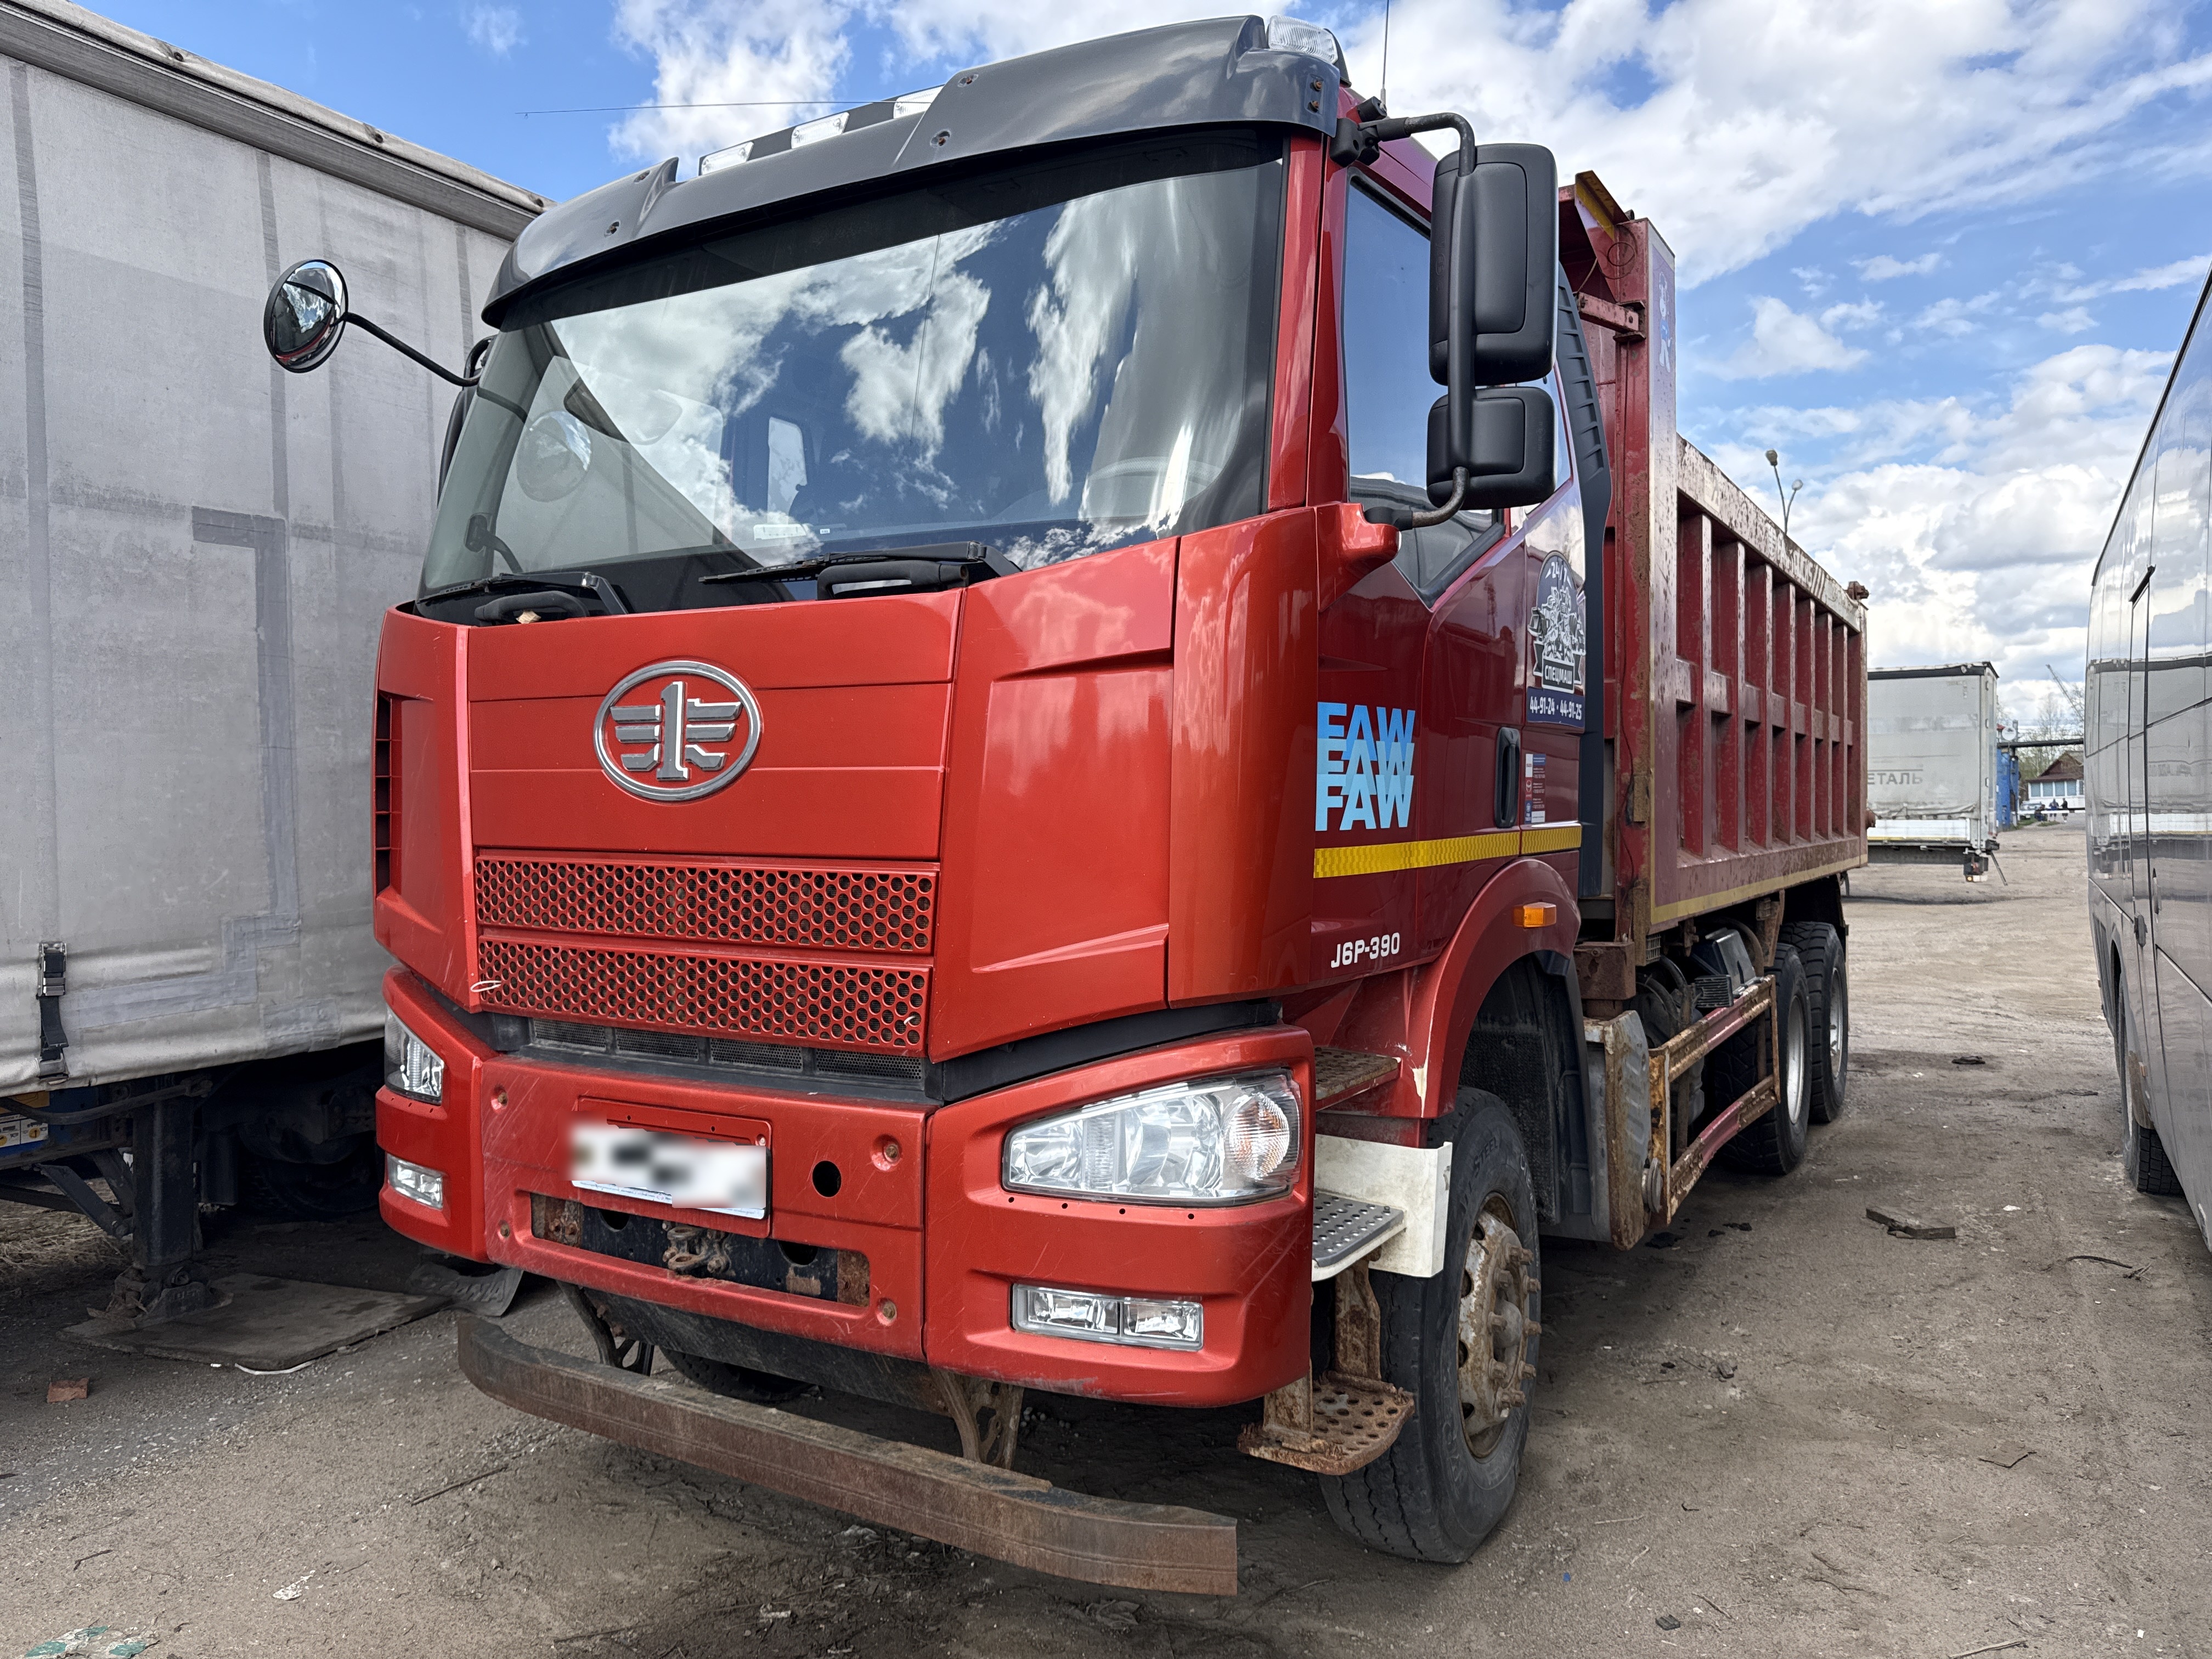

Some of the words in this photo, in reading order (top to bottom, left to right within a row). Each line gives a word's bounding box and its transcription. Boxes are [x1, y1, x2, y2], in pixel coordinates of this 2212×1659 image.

[1551, 561, 1567, 583] 24/7
[1544, 665, 1572, 685] СПЕЦМАШ
[1530, 696, 1555, 715] 44-91-24
[1560, 699, 1582, 720] 44-91-25
[1315, 774, 1414, 831] FAW
[1330, 932, 1400, 968] J6P-390
